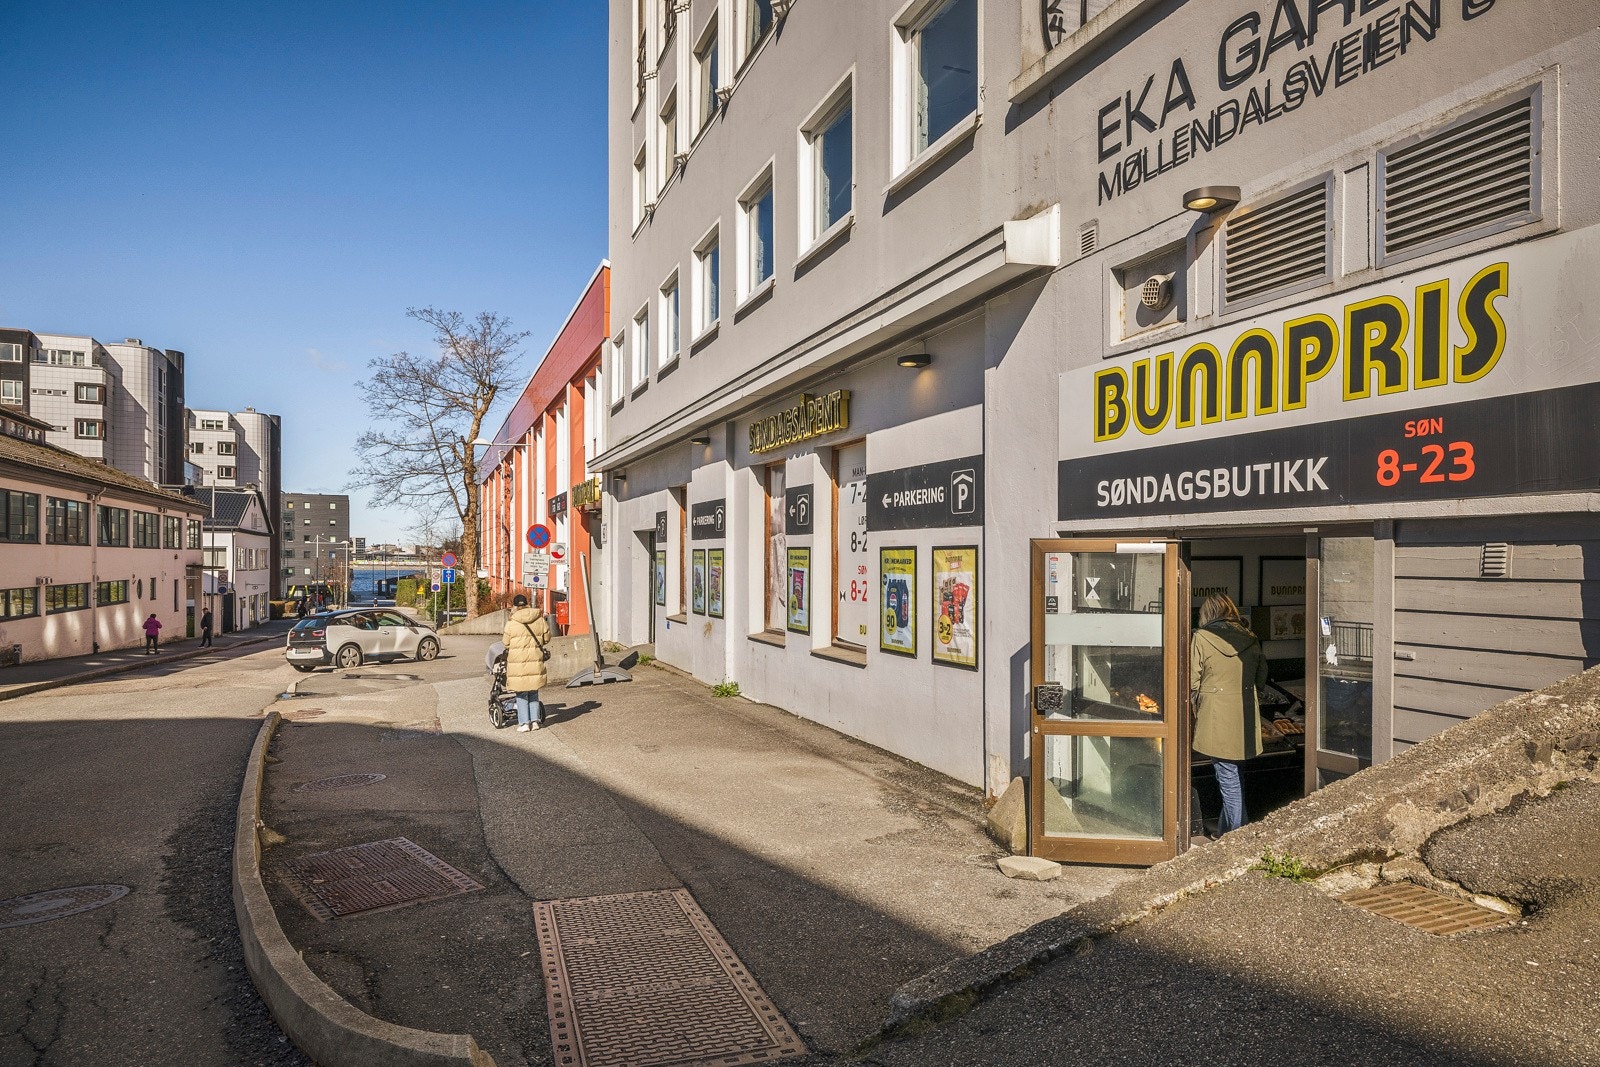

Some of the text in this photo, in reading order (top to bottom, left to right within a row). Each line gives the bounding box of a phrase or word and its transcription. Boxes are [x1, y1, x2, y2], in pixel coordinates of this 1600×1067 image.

[1098, 0, 1441, 206] MØLLENDALSVEIEN
[1098, 57, 1196, 163] EKA
[1094, 262, 1509, 442] BUNNPRIS
[749, 389, 846, 454] SØNDAGSÅPENT
[1404, 417, 1443, 439] SØN
[852, 466, 867, 477] MAN-
[1097, 456, 1329, 507] SØNDAGSBUTIKK
[1376, 441, 1476, 487] 8-23
[893, 486, 945, 508] PARKERING
[1192, 586, 1228, 597] UNNPRIS
[886, 614, 895, 628] 90
